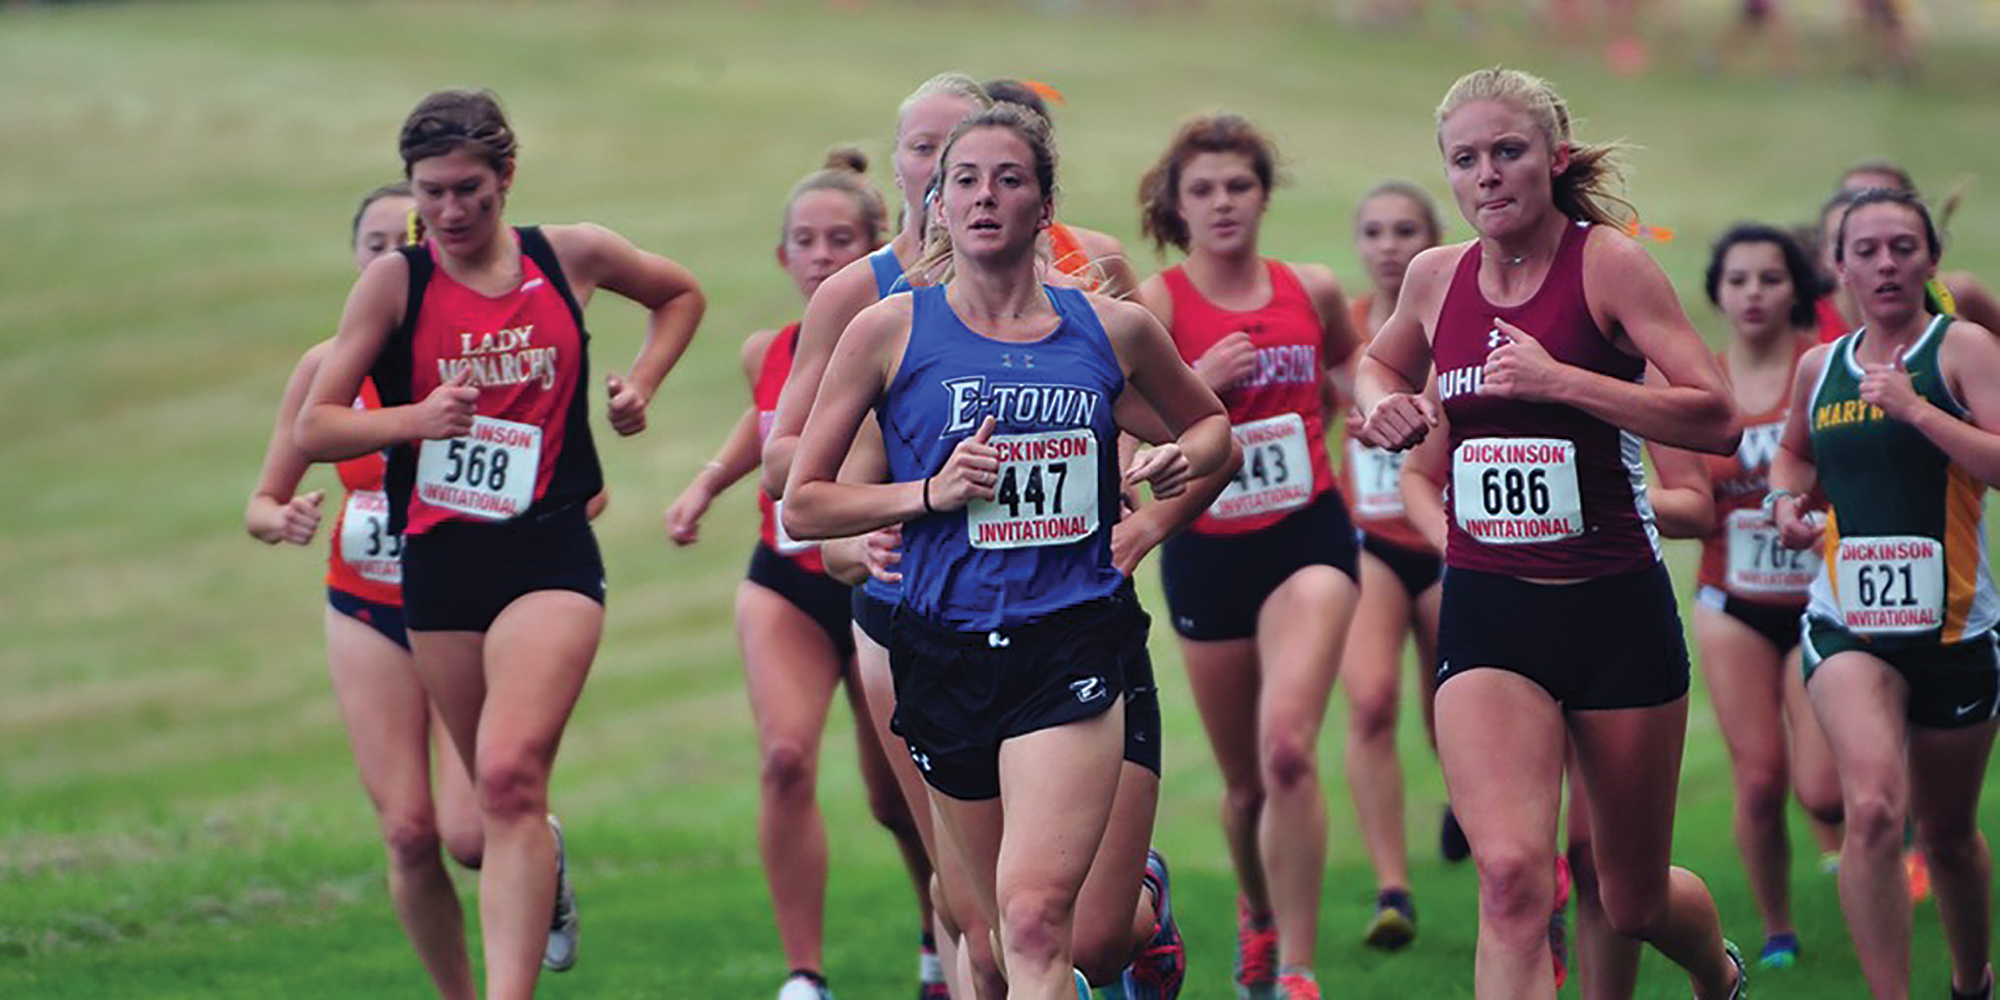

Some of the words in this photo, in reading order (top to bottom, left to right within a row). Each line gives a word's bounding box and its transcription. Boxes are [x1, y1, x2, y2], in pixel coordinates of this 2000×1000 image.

[461, 325, 534, 356] LADY
[437, 345, 557, 390] MONARCHS
[940, 376, 1101, 439] E-TOWN
[474, 422, 533, 449] INSON
[988, 437, 1088, 463] CKINSON
[443, 440, 510, 492] 568
[1462, 444, 1566, 464] DICKINSON
[422, 482, 520, 515] INVITATIONAL
[998, 461, 1068, 518] 447
[1482, 467, 1550, 516] 686
[977, 516, 1090, 543] INVITATIONAL
[1465, 518, 1575, 538] INVITATIONAL
[1842, 542, 1934, 561] DICKINSON
[1858, 563, 1919, 608] 621
[1846, 607, 1937, 627] INVITATIONAL
